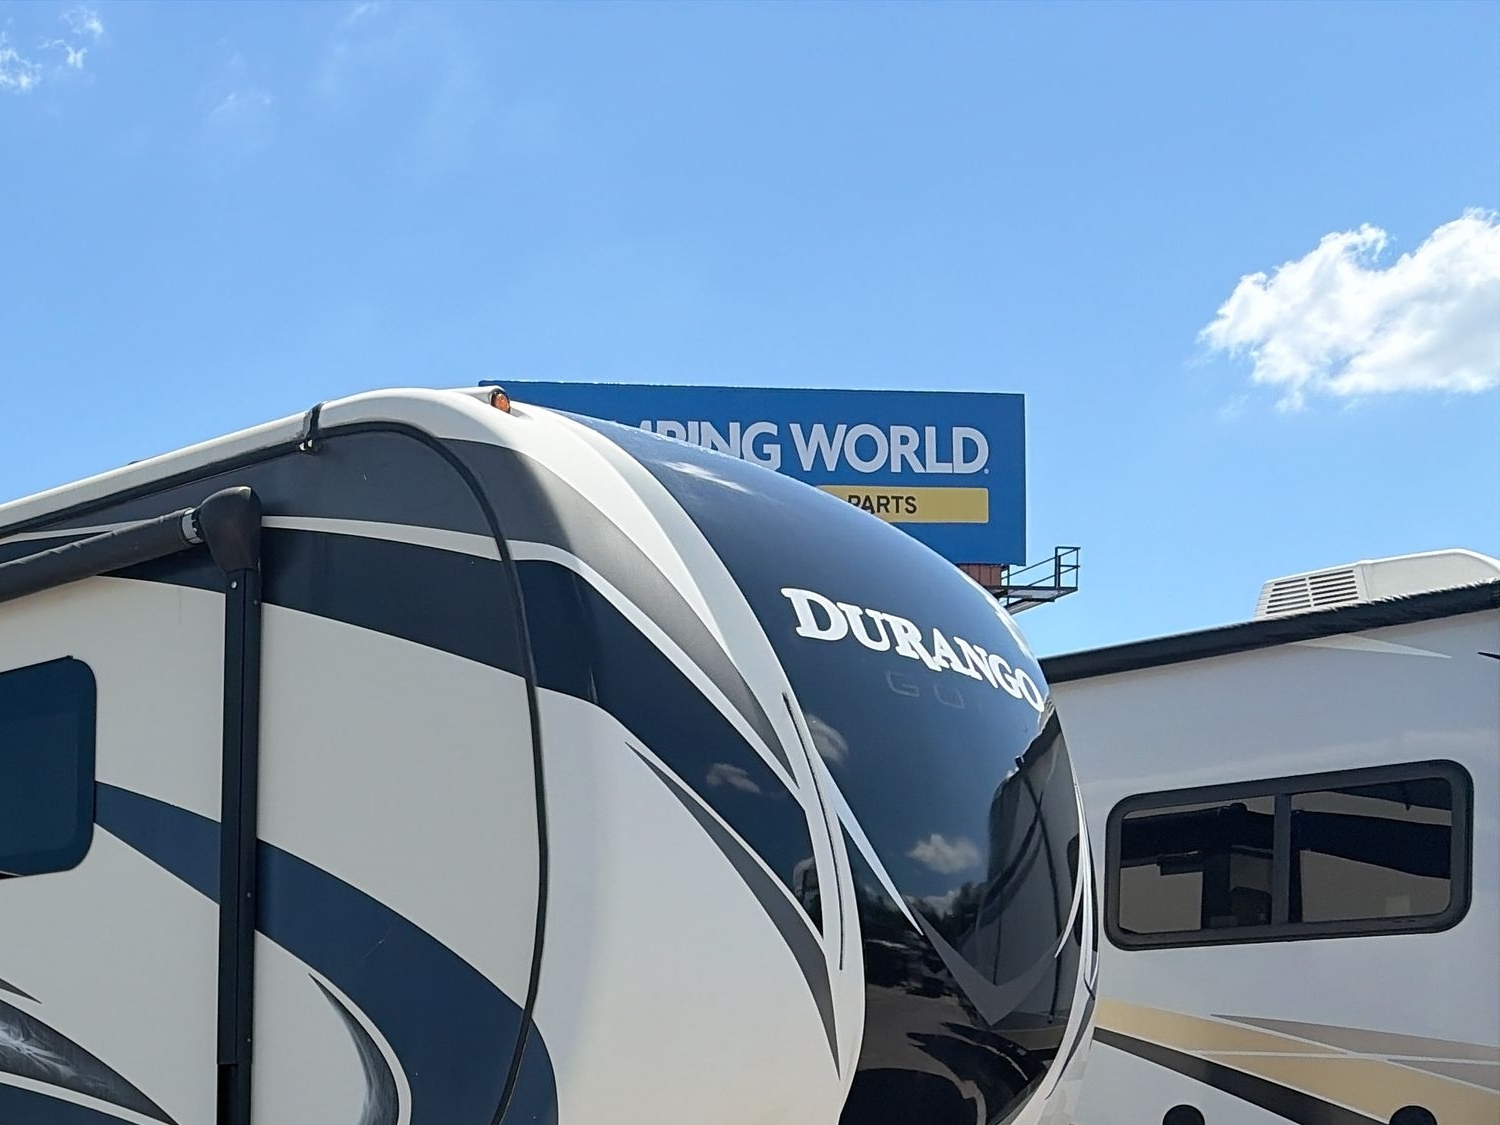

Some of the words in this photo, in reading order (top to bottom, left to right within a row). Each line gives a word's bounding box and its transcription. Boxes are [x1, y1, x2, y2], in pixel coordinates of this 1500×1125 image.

[790, 423, 988, 474] WORLD
[848, 494, 917, 514] PARTS
[781, 587, 1044, 712] DURANGO
